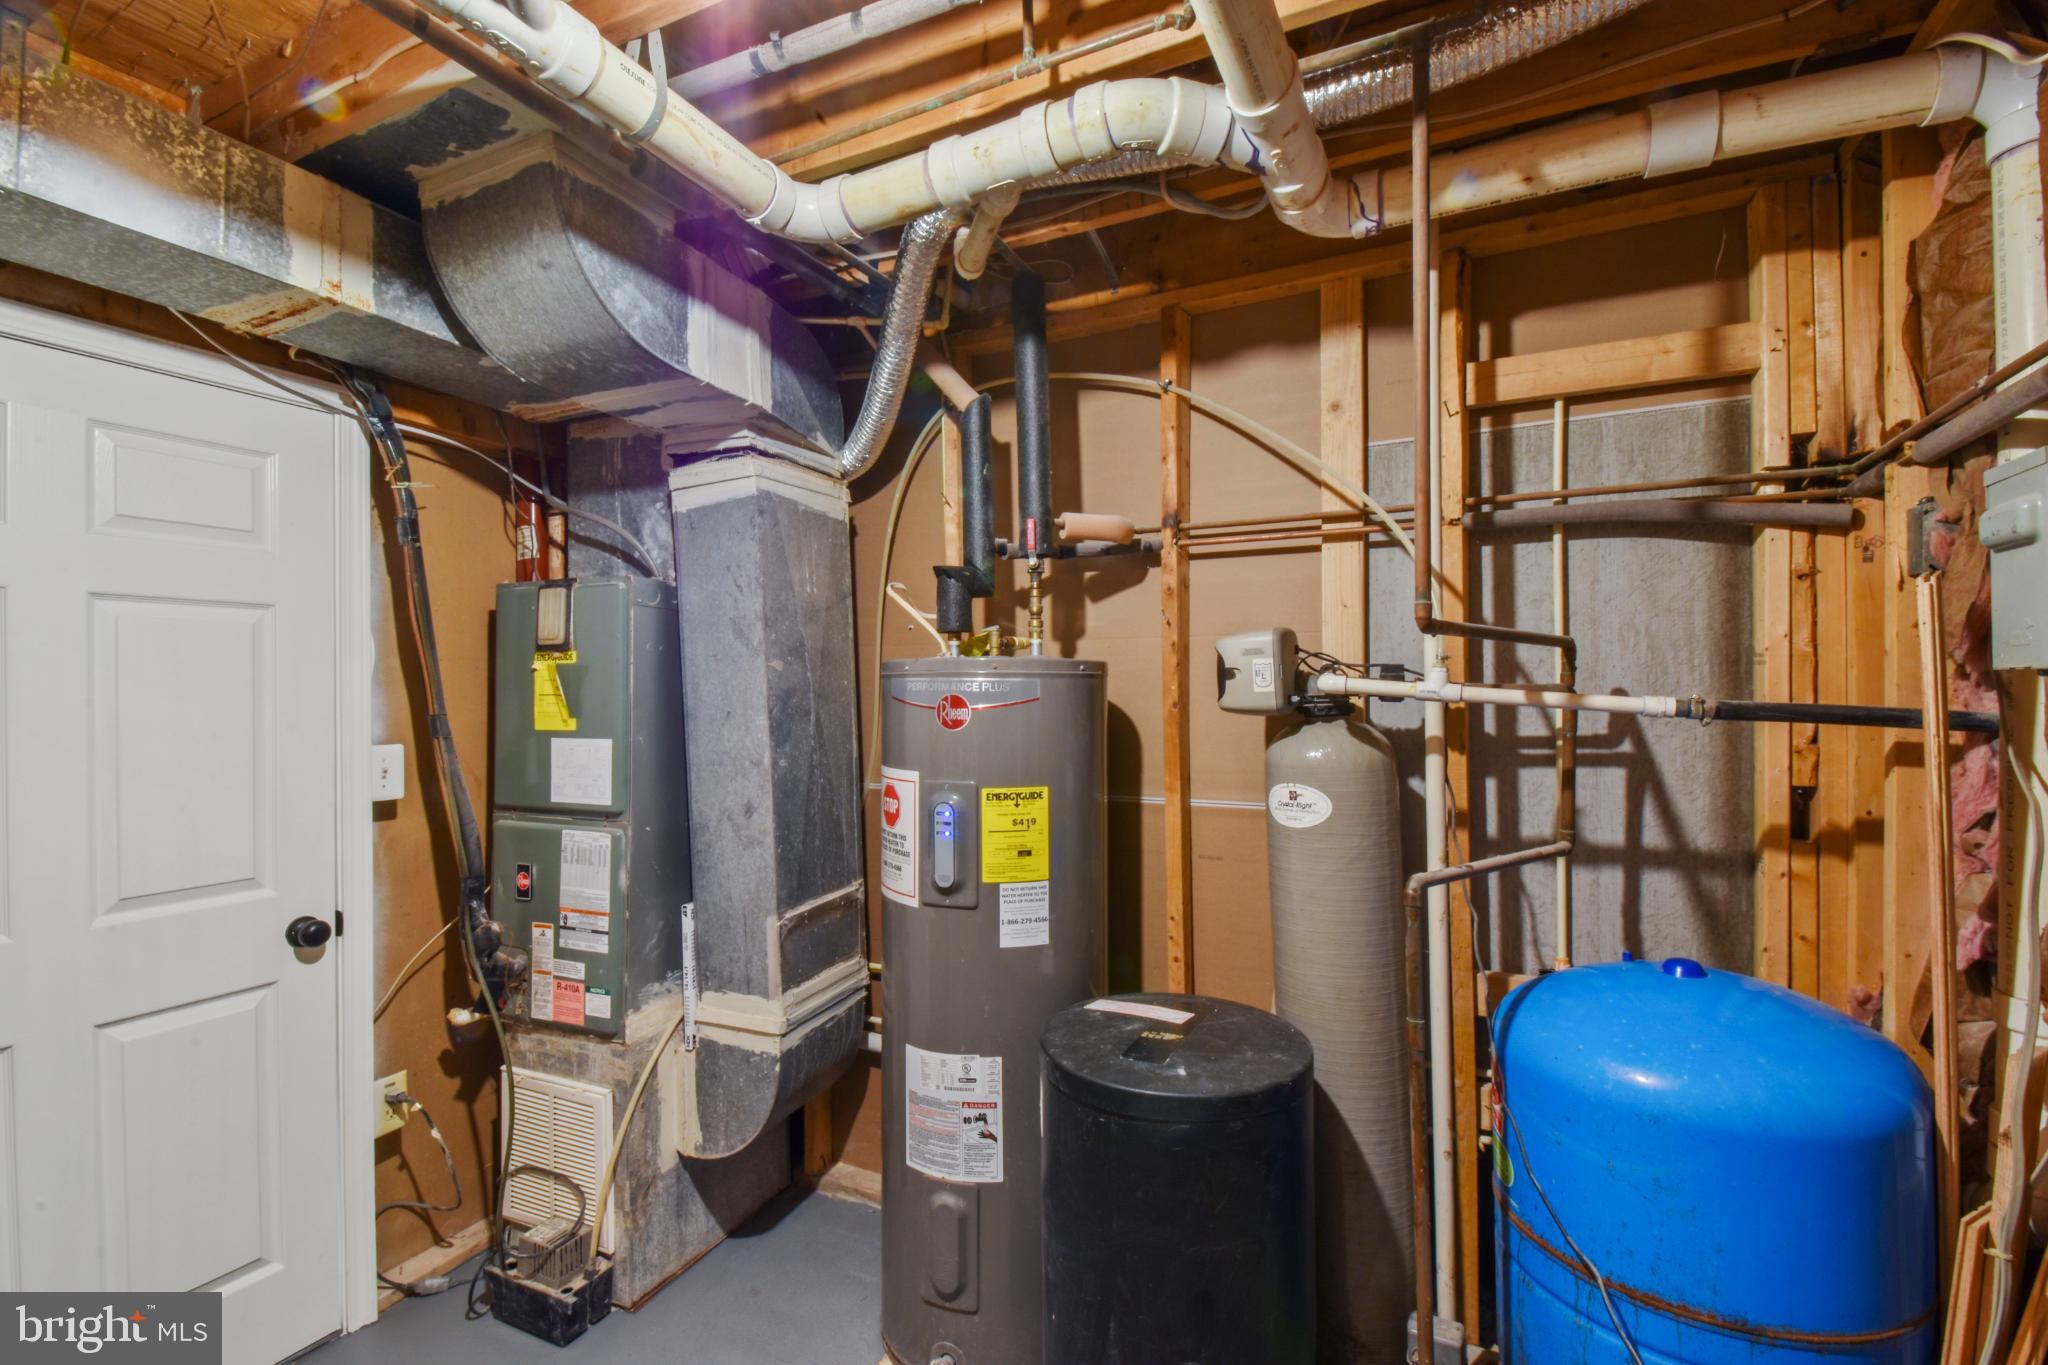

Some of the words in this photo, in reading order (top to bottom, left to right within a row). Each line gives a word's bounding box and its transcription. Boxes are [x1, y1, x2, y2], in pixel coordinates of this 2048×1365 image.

[906, 682, 980, 692] PERFORMANCE
[982, 682, 1010, 692] PLUS
[939, 695, 969, 725] Rheem
[986, 790, 1044, 803] ENERGYGUIDE
[1012, 817, 1037, 827] $419
[556, 981, 580, 994] R-410A
